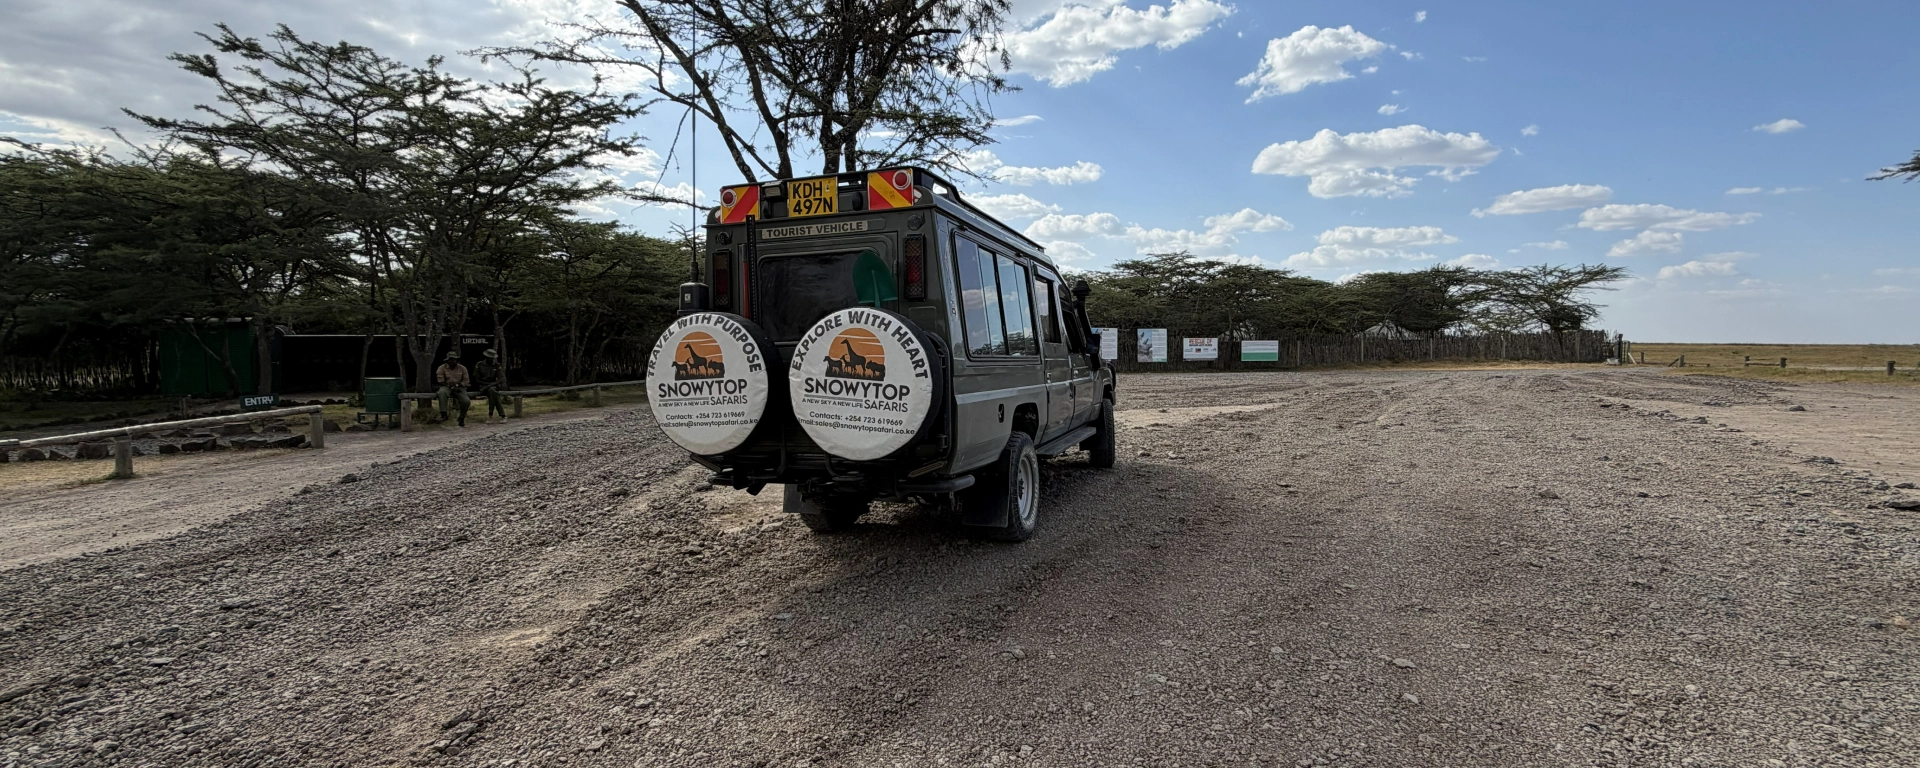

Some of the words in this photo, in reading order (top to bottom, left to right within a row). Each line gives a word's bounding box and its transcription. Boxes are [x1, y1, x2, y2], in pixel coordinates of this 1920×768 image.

[792, 181, 823, 199] KDH
[793, 197, 833, 215] 497N
[767, 226, 813, 238] TOURIST
[816, 222, 863, 233] VEHICLE
[647, 328, 675, 378] TRAVEL
[677, 314, 712, 330] WITH
[713, 315, 762, 373] PURPOSE
[792, 315, 843, 372] EXPLORE
[848, 310, 893, 332] WITH
[890, 325, 929, 380] HEART
[658, 379, 748, 398] SNOWYTOP
[804, 377, 911, 401] SNOWYTOP
[244, 395, 274, 407] ENTRY
[710, 395, 748, 406] SAFARIS
[864, 399, 909, 413] SAFARIS
[809, 411, 843, 421] Contacts:
[863, 416, 876, 424] 723
[877, 418, 903, 426] 619669
